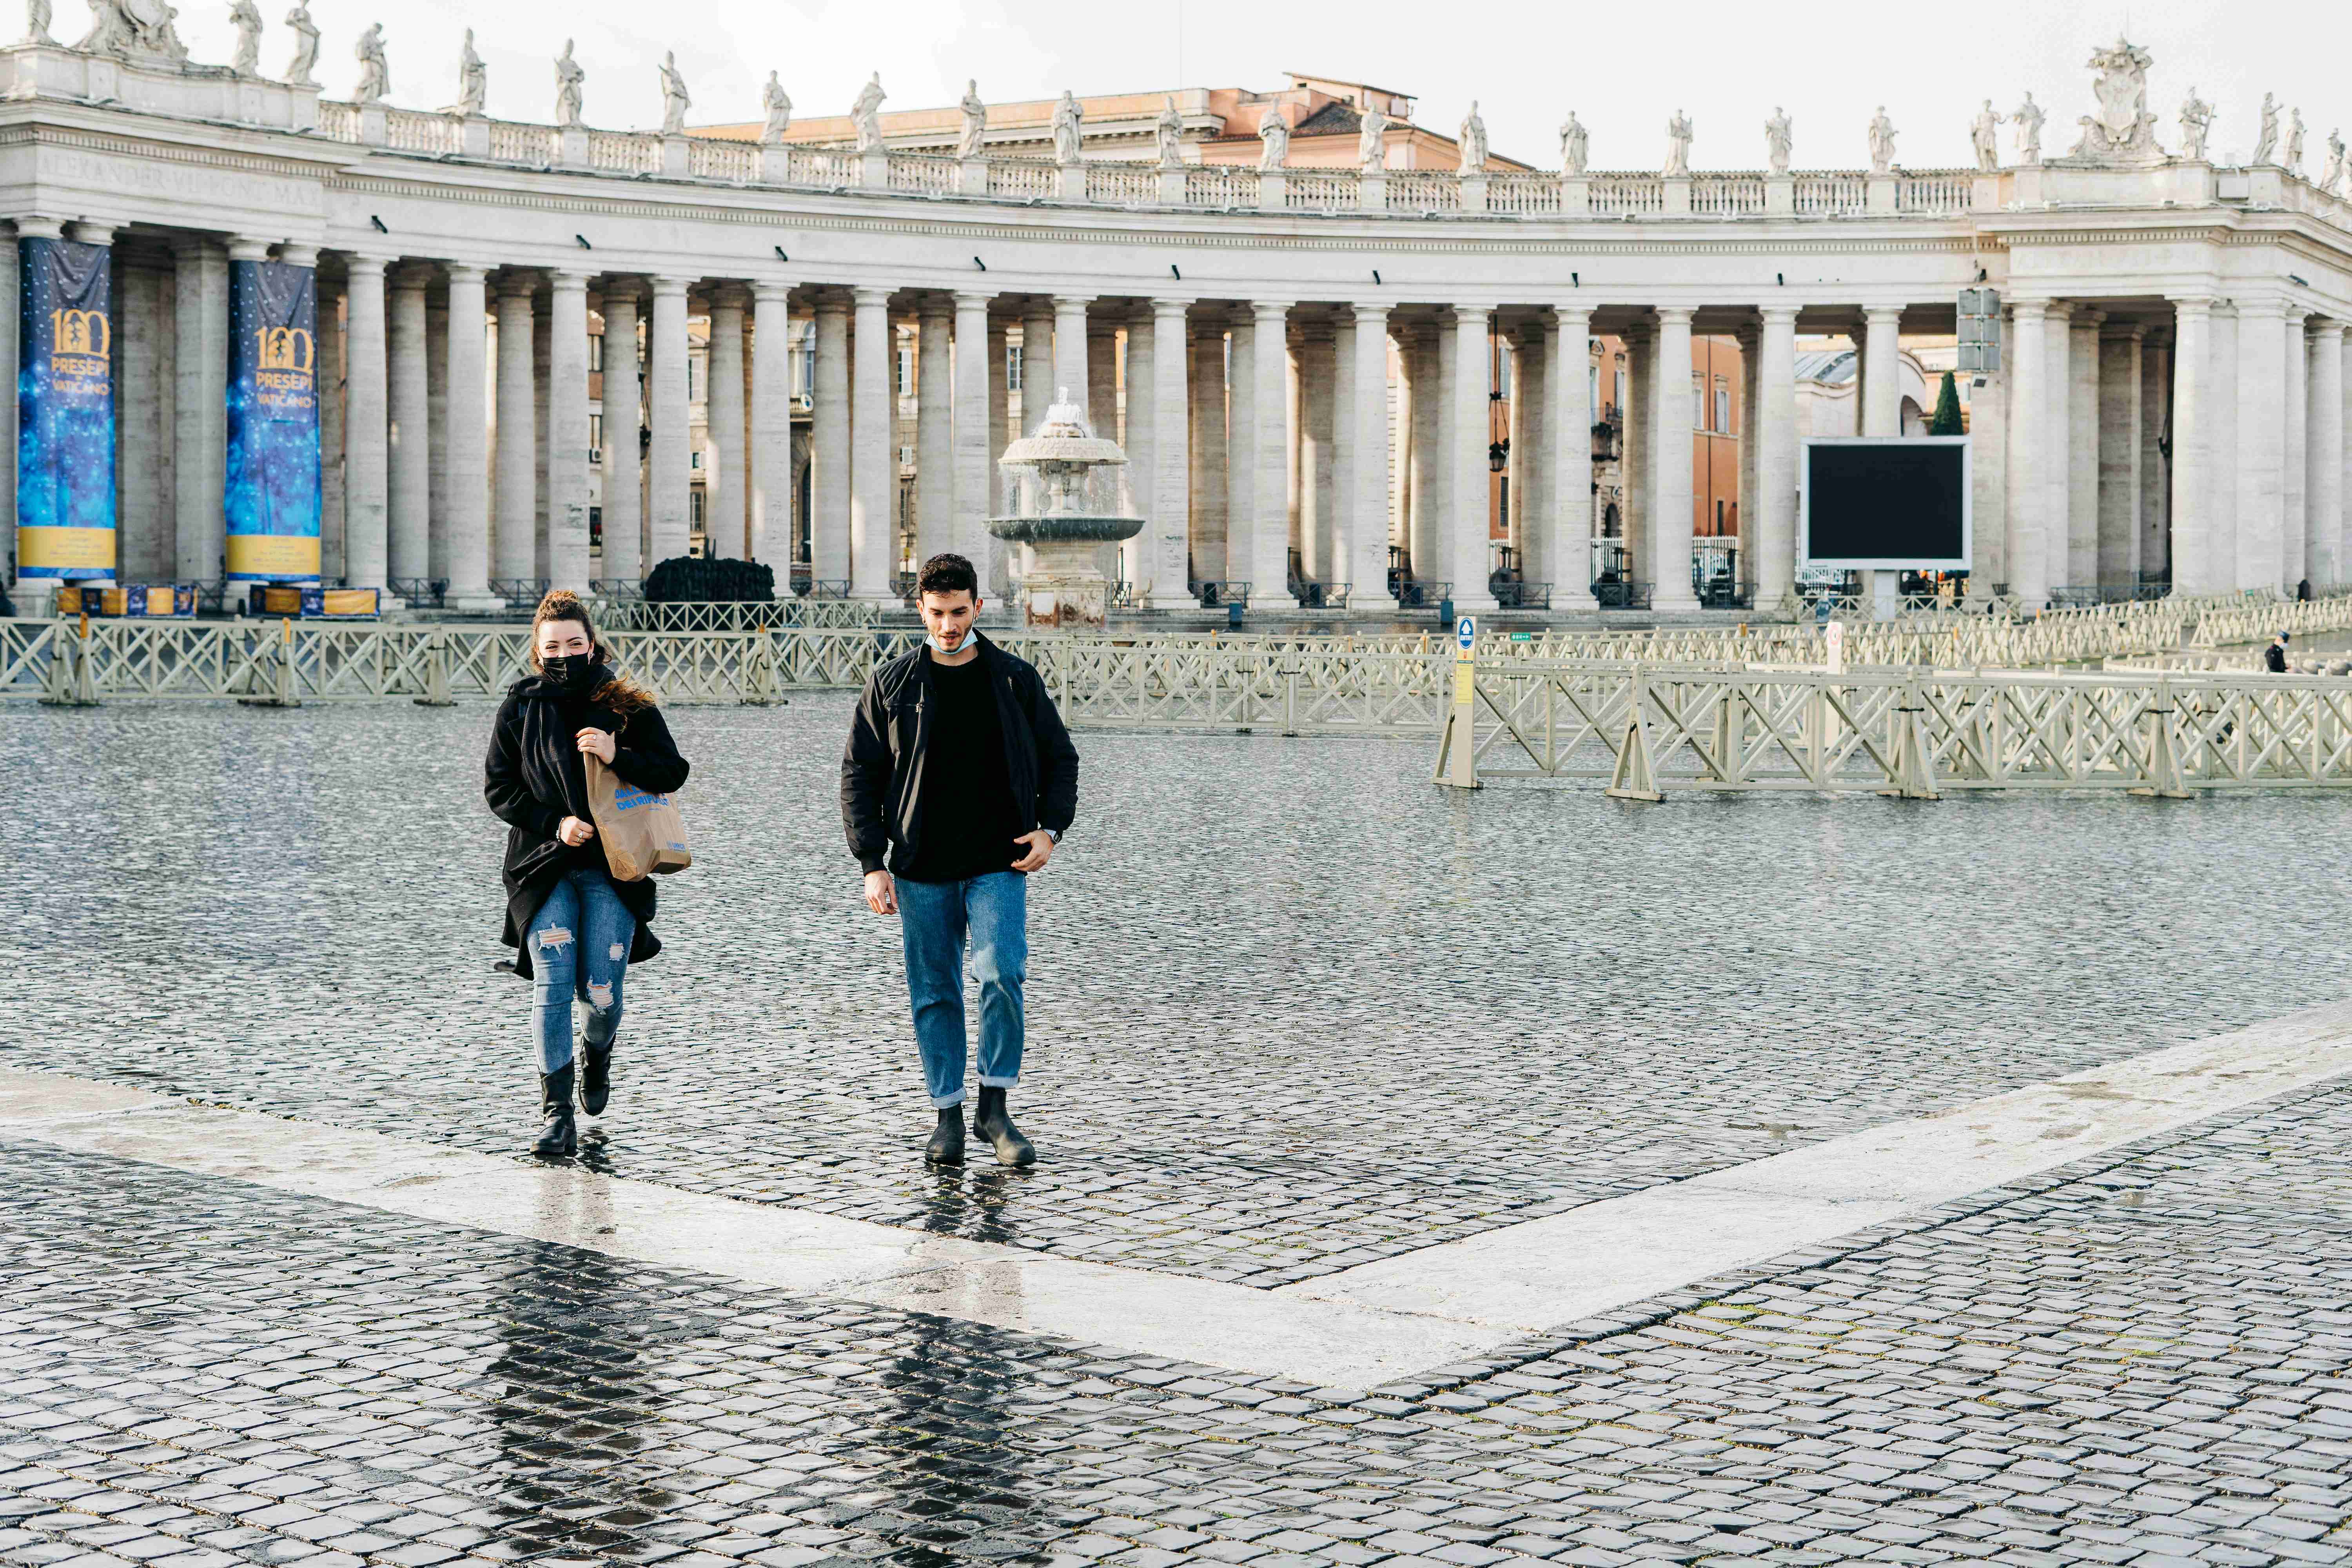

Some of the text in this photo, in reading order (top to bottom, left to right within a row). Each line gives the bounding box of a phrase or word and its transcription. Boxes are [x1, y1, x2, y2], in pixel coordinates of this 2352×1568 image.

[50, 308, 110, 360] 100
[254, 326, 313, 375] 100
[51, 357, 109, 377] PRESEPI
[256, 372, 313, 390] PRESEPI
